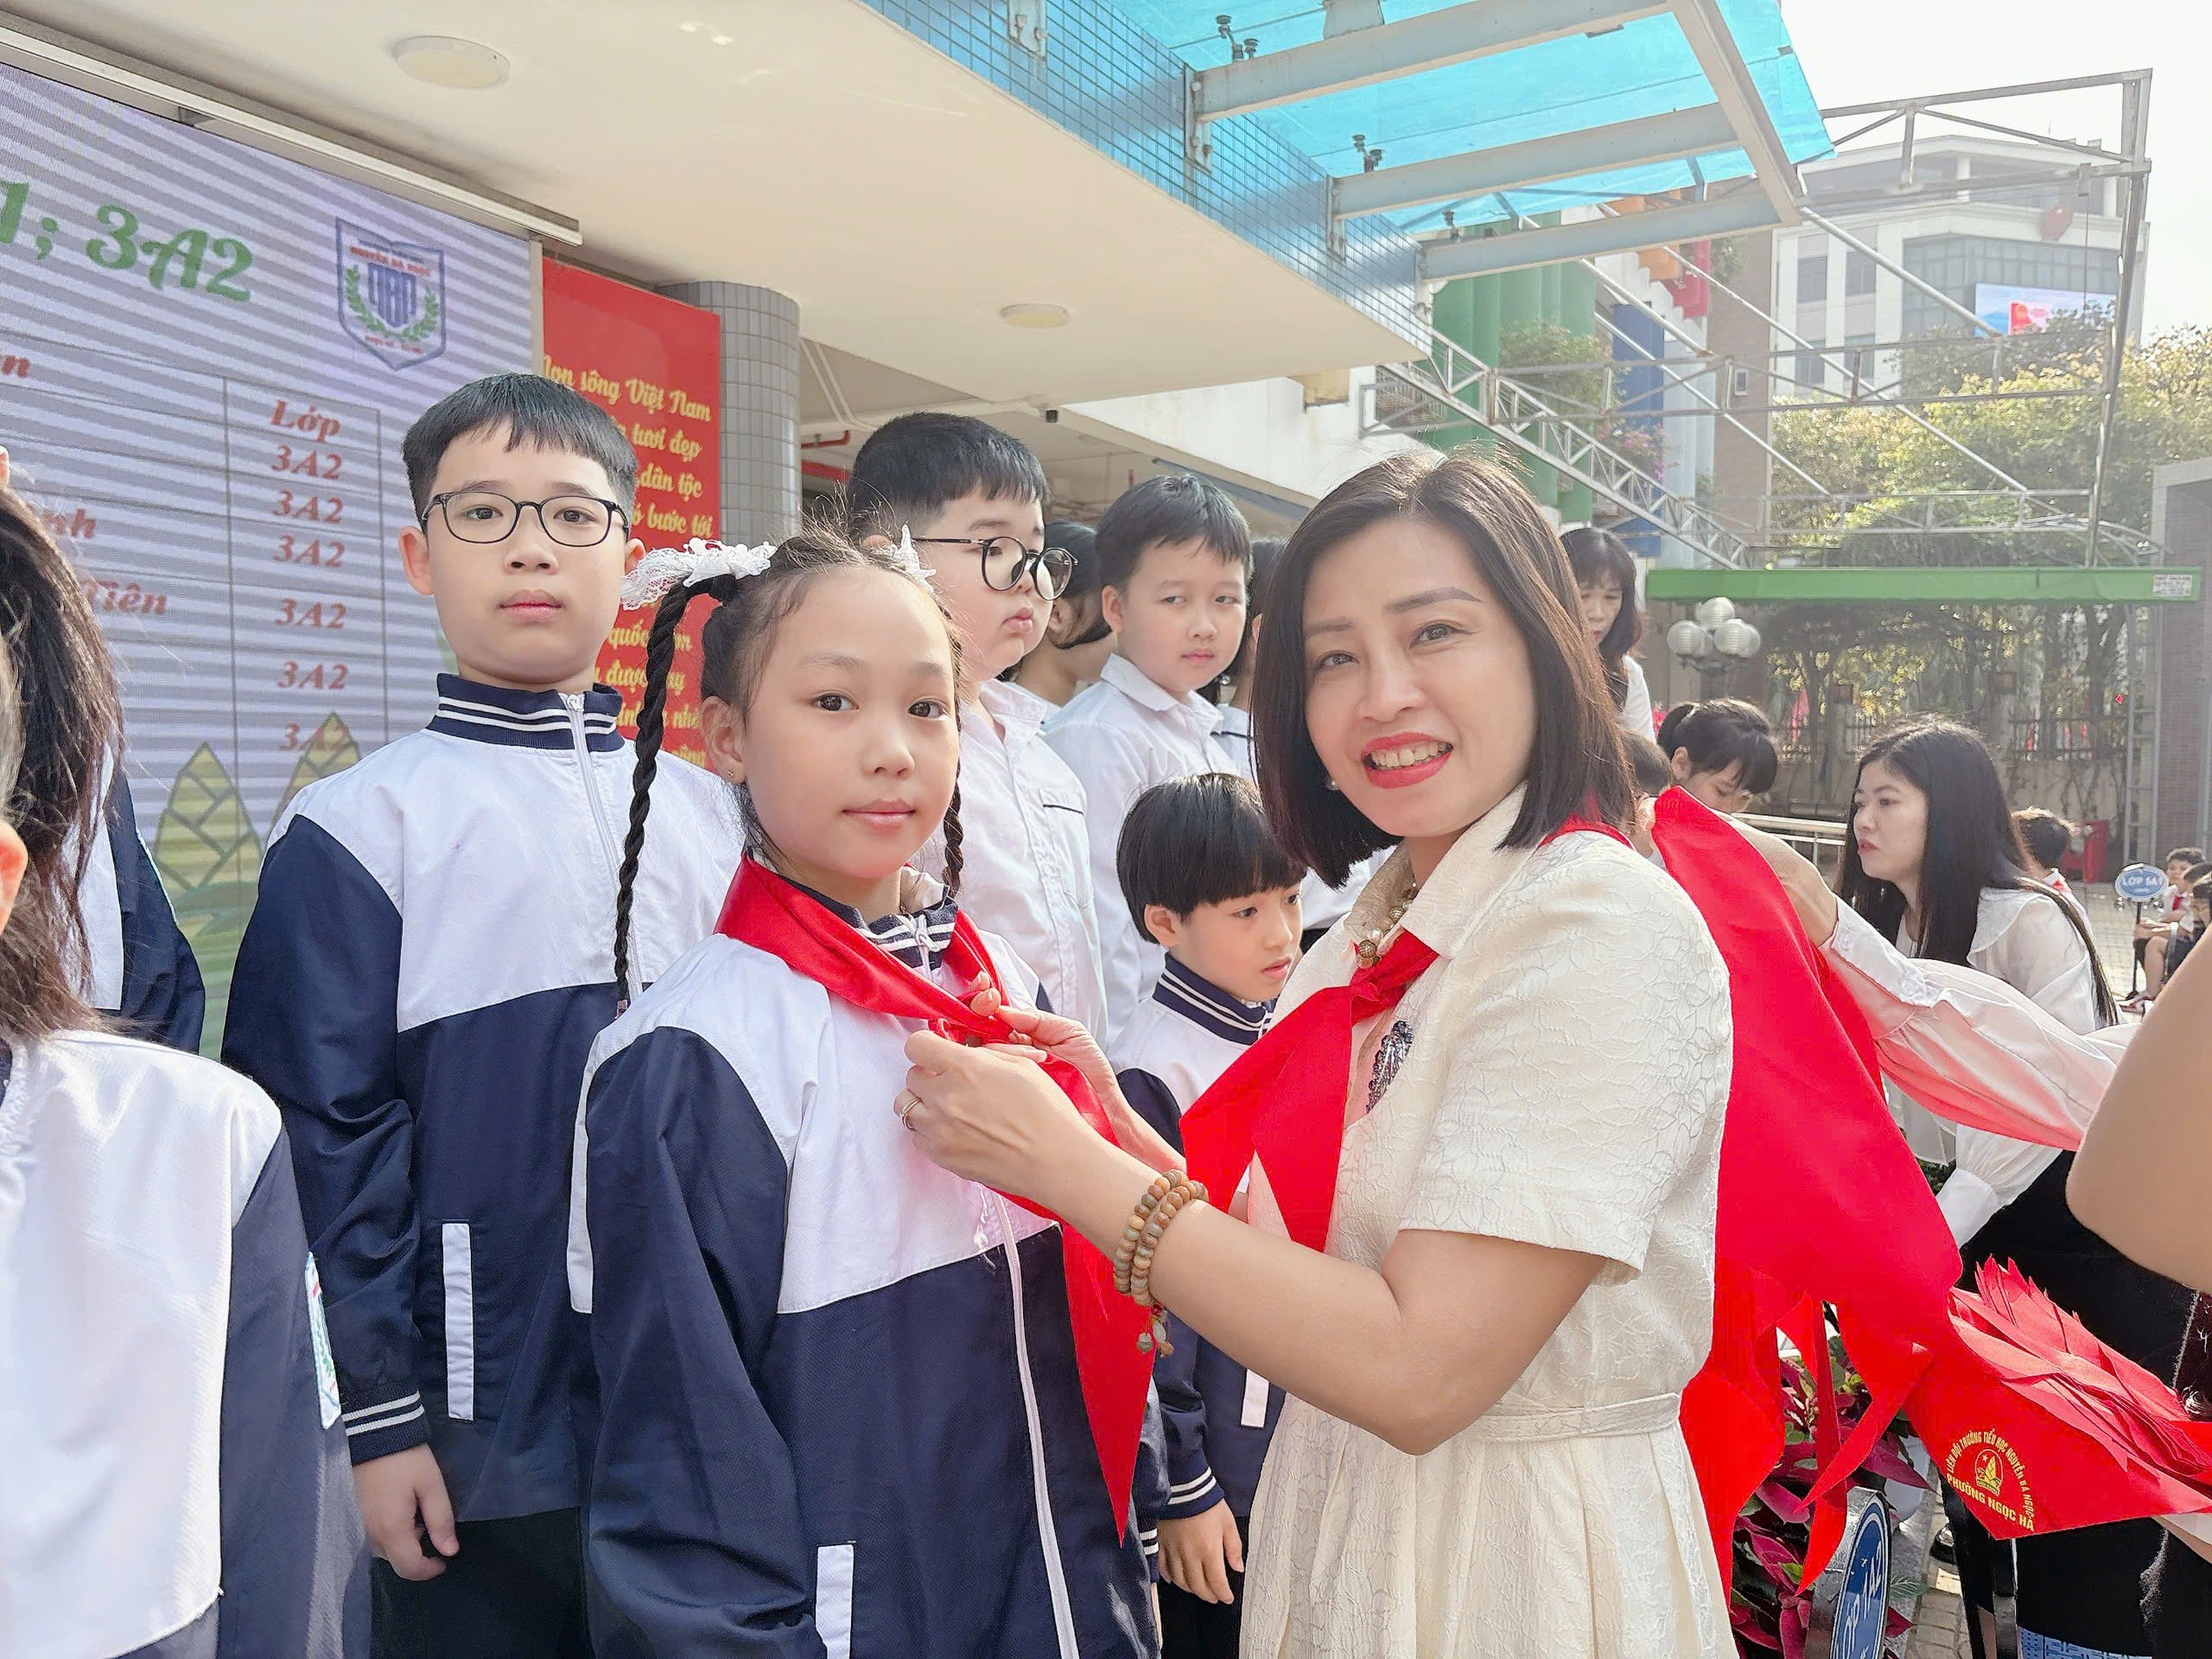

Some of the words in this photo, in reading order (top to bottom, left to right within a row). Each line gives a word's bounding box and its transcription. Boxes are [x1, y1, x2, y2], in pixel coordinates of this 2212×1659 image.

[86, 204, 253, 302] 3A2
[625, 377, 665, 415] Việt
[669, 389, 712, 423] Nam
[270, 400, 341, 443] Lớp
[632, 422, 666, 451] tươi
[669, 429, 703, 462] đẹp
[271, 445, 343, 480] 3A2
[639, 462, 675, 493] dân
[677, 473, 703, 502] tộc
[273, 489, 344, 524] 3A2
[648, 502, 688, 535] bước
[275, 534, 346, 567] 3A2
[276, 597, 346, 629] 3A2
[276, 659, 348, 690] 3A2
[277, 722, 349, 751] 3A2
[1946, 1472, 1986, 1504] PHƯỜNG
[1987, 1497, 2017, 1522] NGỌC
